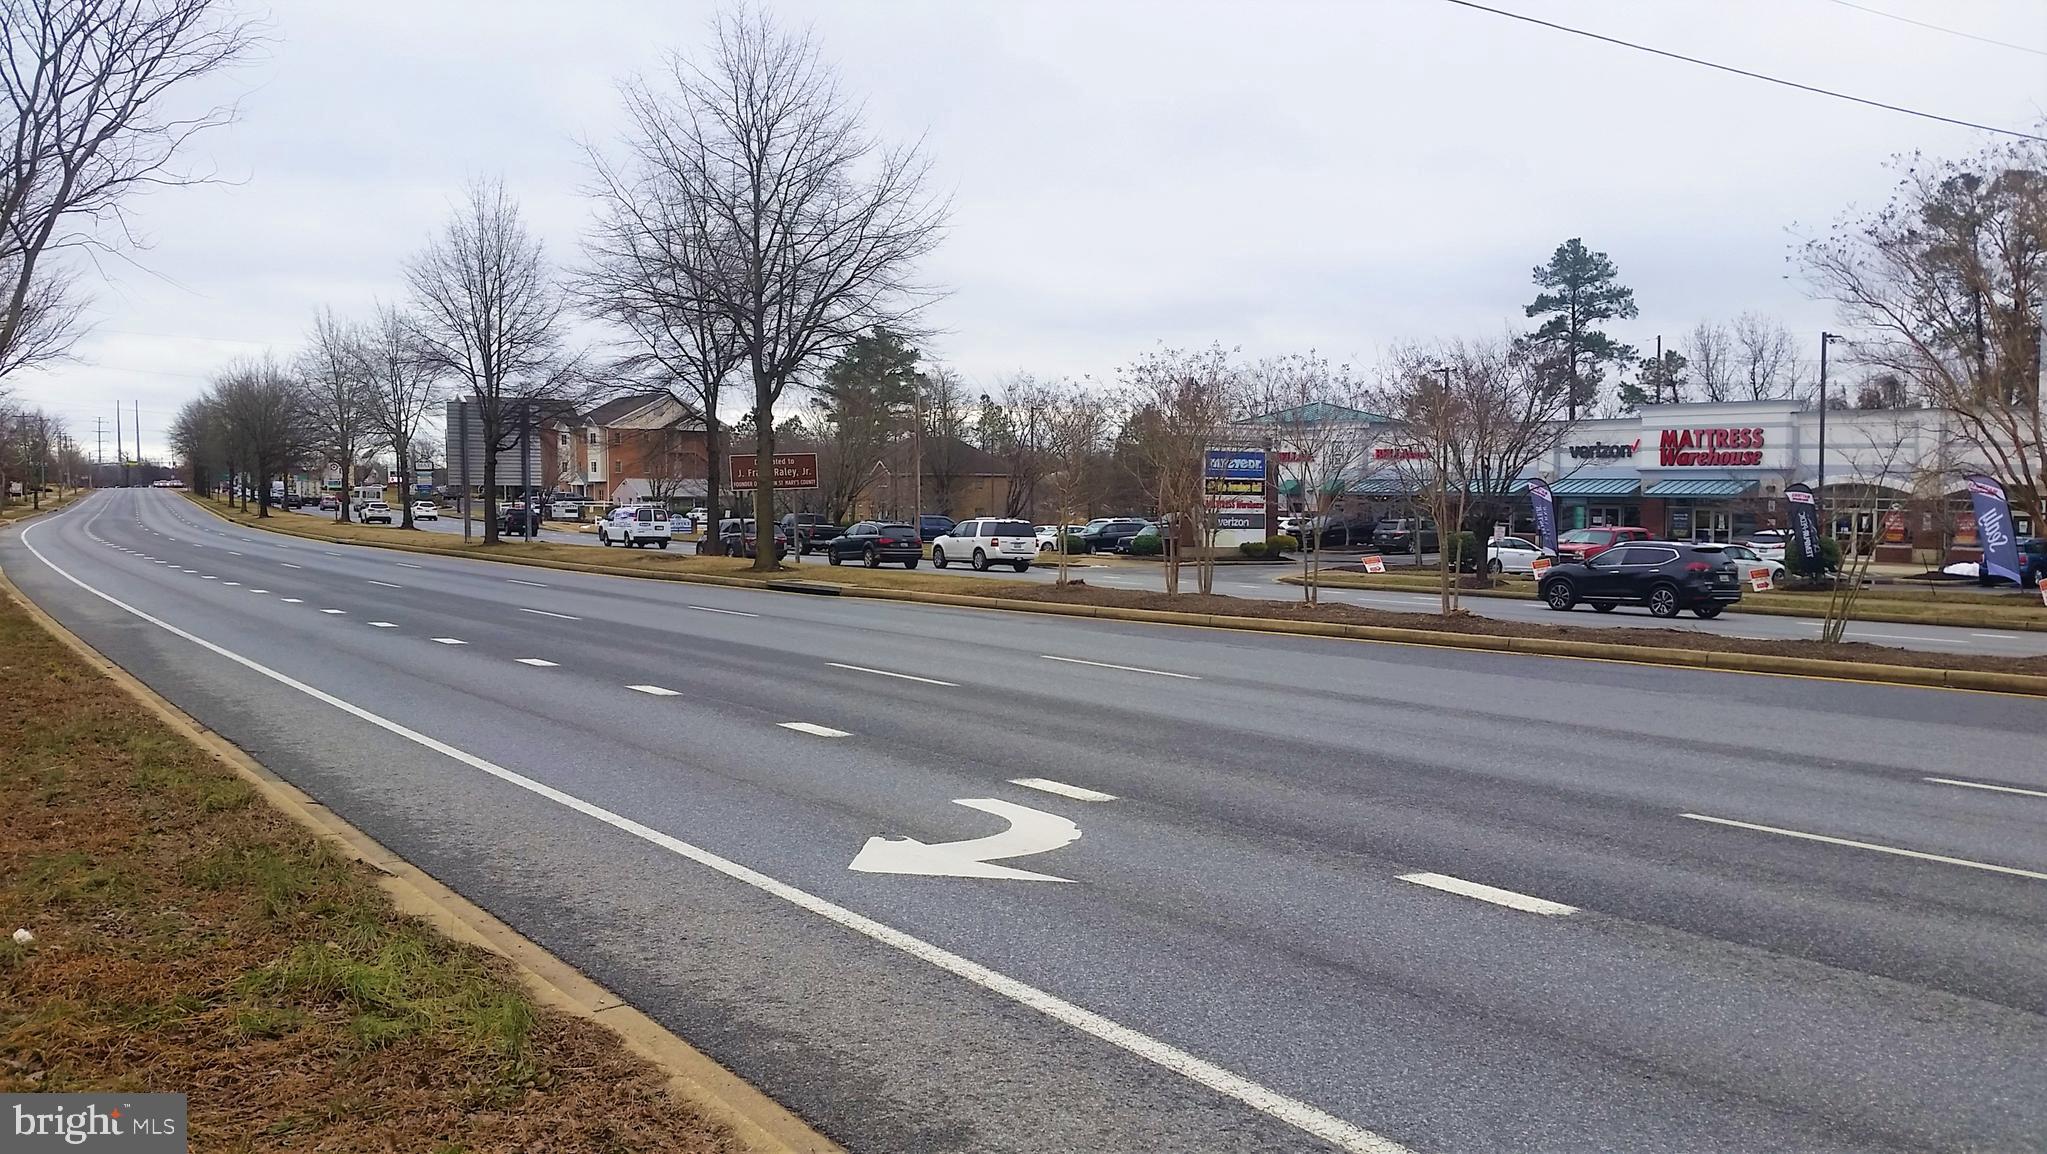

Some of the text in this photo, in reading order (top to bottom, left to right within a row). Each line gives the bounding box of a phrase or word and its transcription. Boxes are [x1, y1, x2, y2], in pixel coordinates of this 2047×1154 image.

[1660, 428, 1764, 449] MATTRESS
[1569, 441, 1633, 459] verizon
[1659, 447, 1763, 467] Warehouse
[737, 469, 745, 478] J.
[774, 467, 799, 478] Raley,
[802, 467, 812, 476] Jr.
[1217, 517, 1250, 527] verizon
